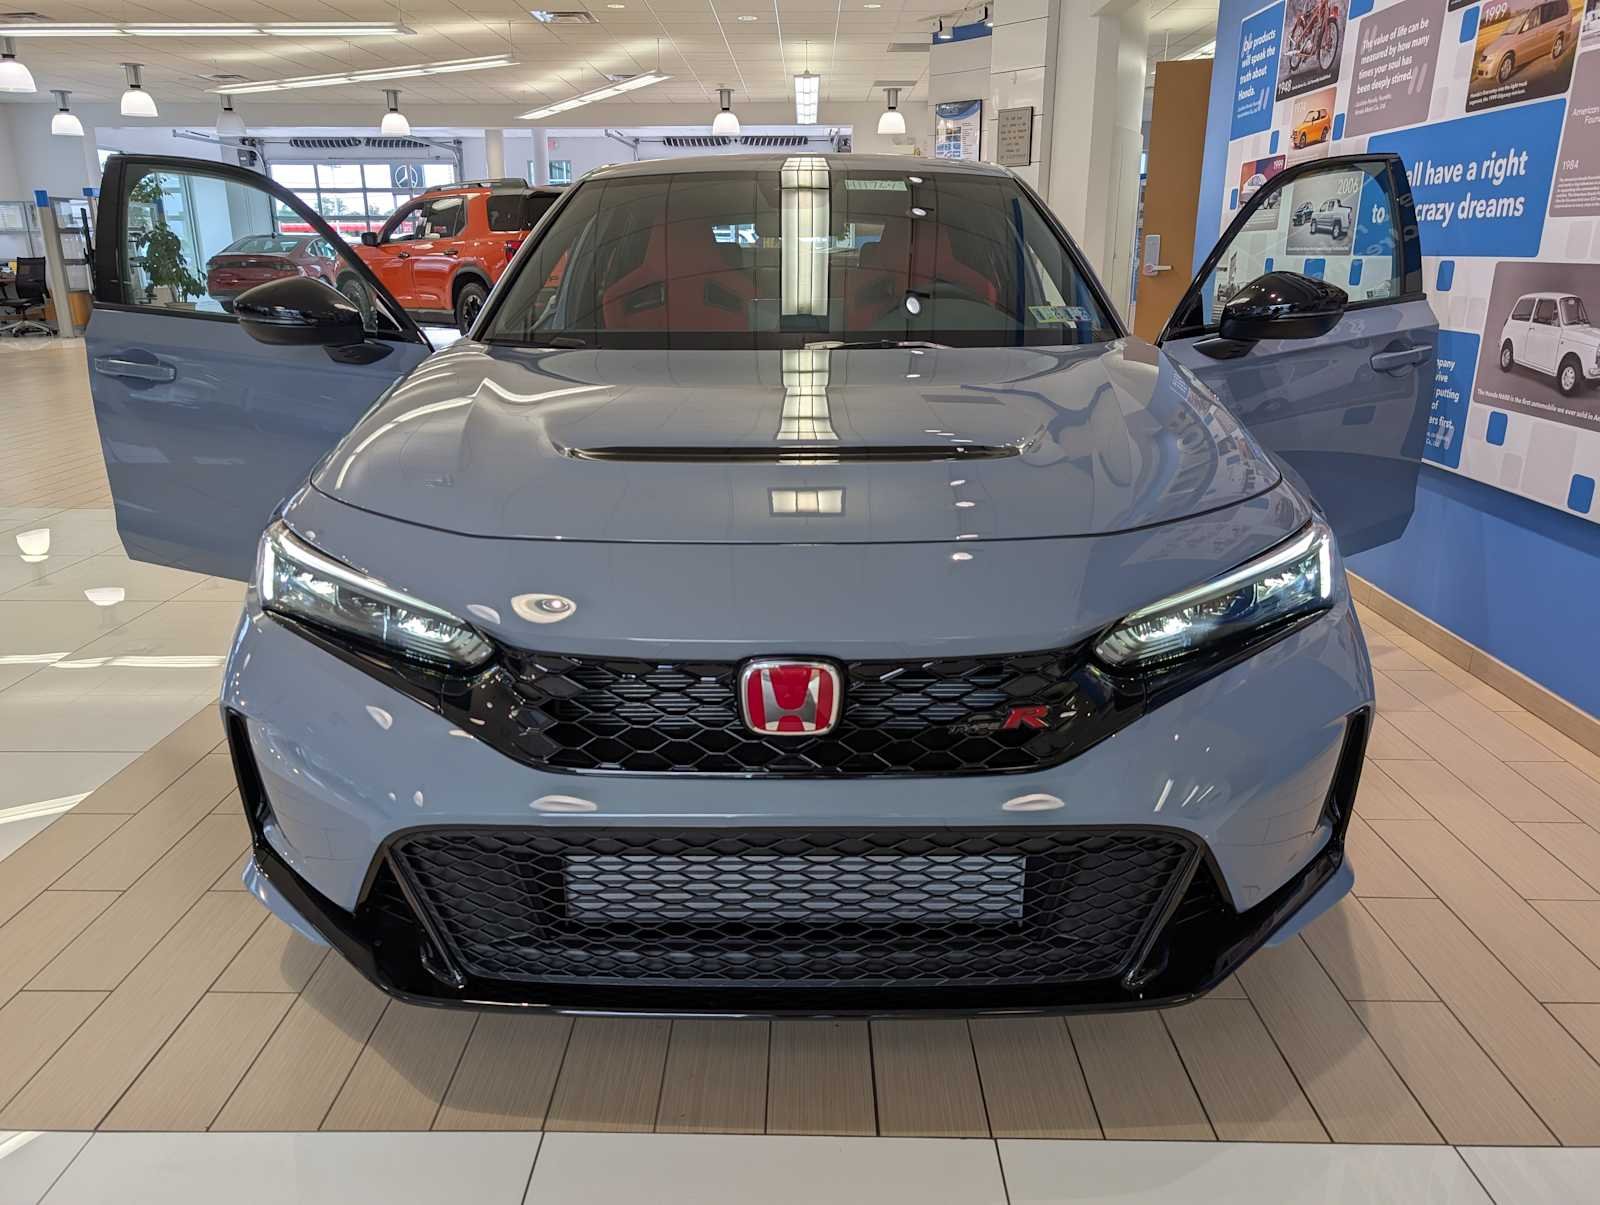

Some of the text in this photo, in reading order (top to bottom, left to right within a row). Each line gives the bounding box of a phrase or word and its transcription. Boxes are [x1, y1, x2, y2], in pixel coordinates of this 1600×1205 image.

[1485, 2, 1508, 23] 1999
[1253, 30, 1276, 49] products
[1363, 18, 1429, 49] The value of life can be
[1241, 46, 1276, 67] will speak the
[1361, 34, 1430, 64] measured by how many
[1240, 65, 1267, 84] truth about
[1359, 56, 1412, 79] times your soul has
[1357, 69, 1413, 94] been deeply stirred.
[1239, 86, 1255, 100] Honda.
[1424, 160, 1463, 186] have
[1466, 161, 1478, 181] a
[1481, 148, 1528, 186] right
[1562, 160, 1580, 170] 1984
[1337, 178, 1360, 194] 2006
[1372, 192, 1525, 228] to crazy dreams
[1431, 400, 1439, 410] of
[1435, 388, 1459, 403] putting
[1565, 408, 1576, 416] ever
[1003, 704, 1050, 729] R
